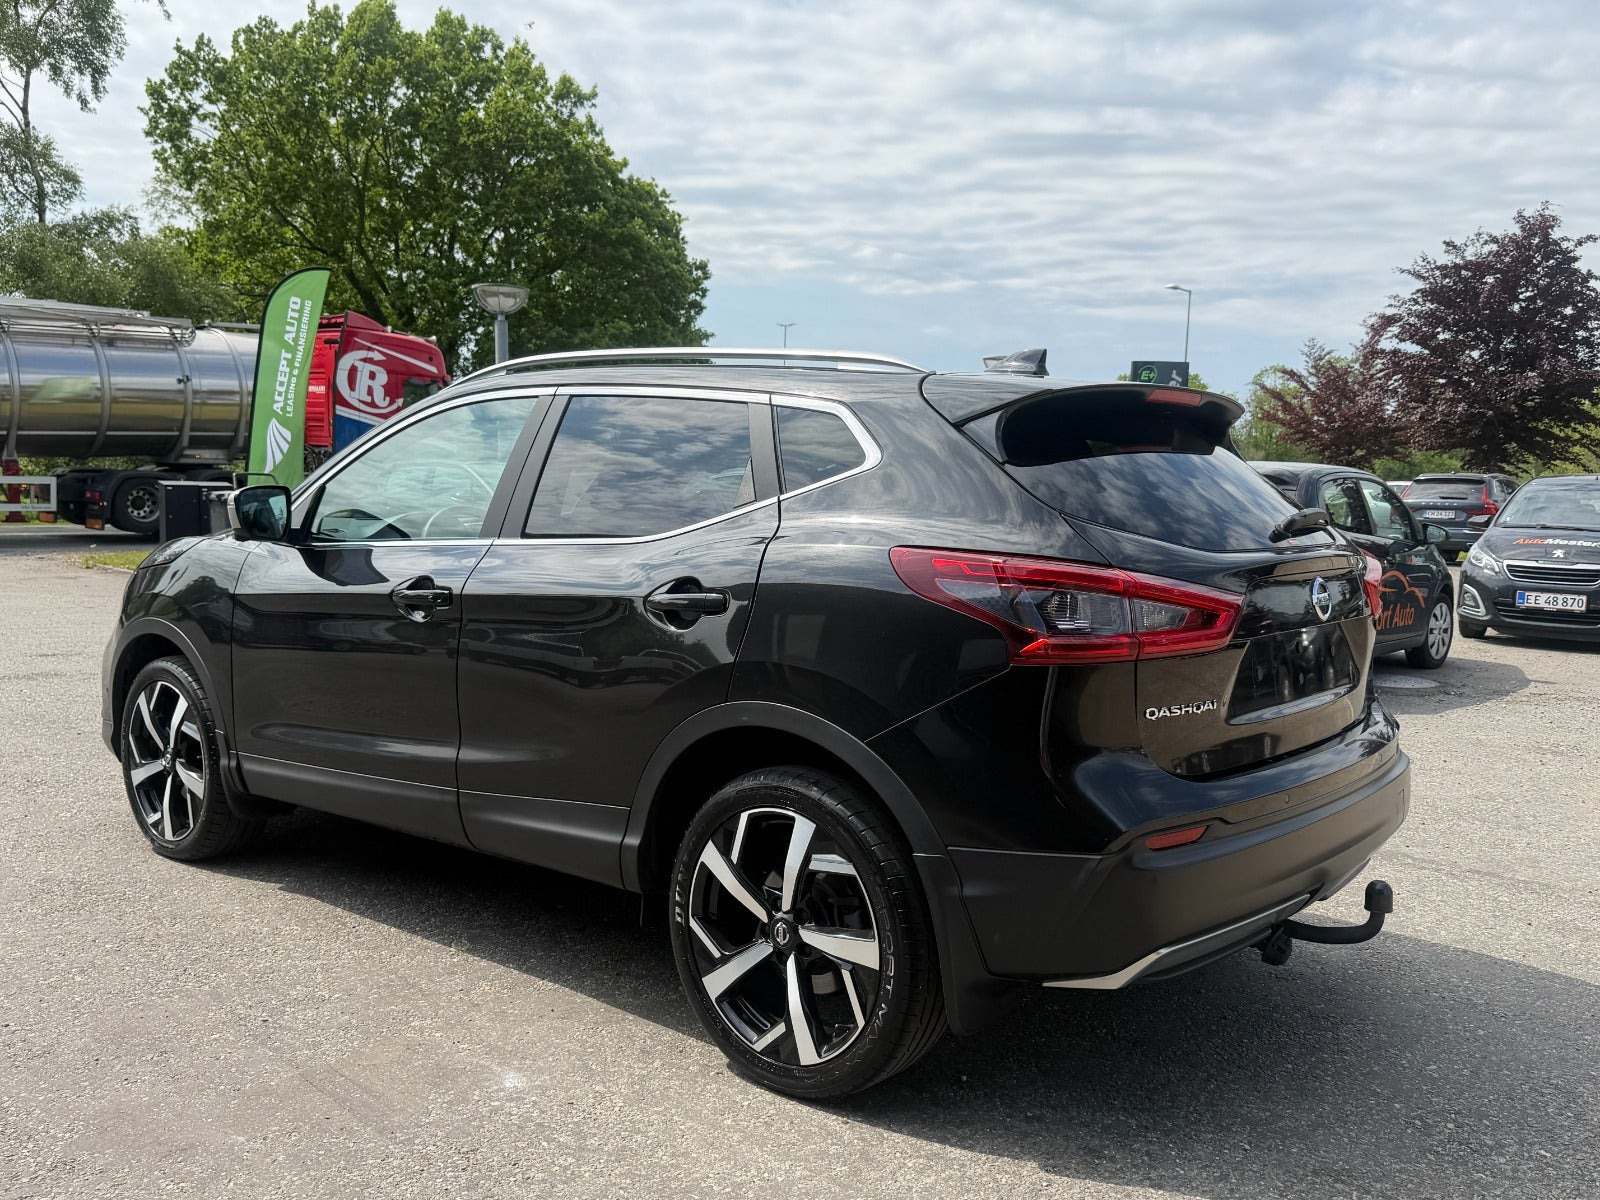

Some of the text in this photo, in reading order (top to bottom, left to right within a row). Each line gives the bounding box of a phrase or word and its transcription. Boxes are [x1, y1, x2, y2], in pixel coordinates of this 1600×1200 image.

[272, 296, 301, 415] ACCEPT AUTO
[286, 378, 297, 417] LEASING
[294, 300, 312, 368] FINANSIERING
[1392, 603, 1415, 628] Auto
[1526, 594, 1585, 609] EE 48 870
